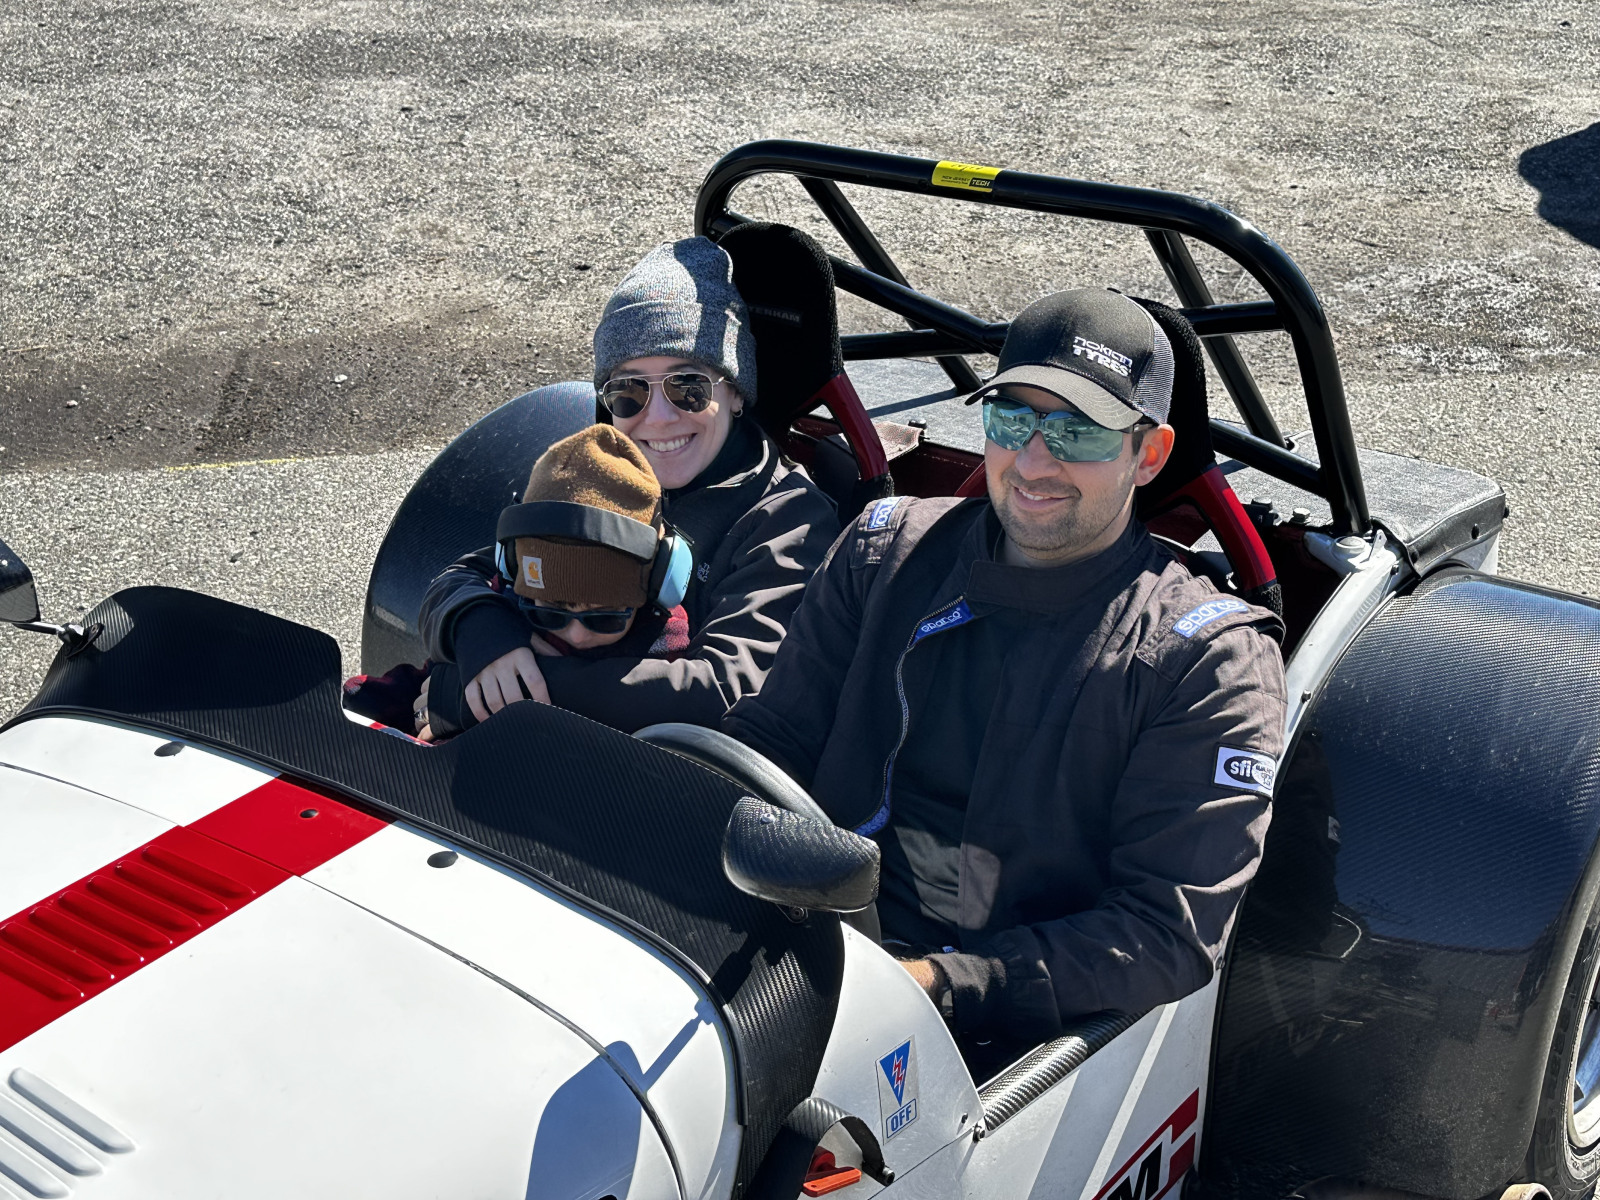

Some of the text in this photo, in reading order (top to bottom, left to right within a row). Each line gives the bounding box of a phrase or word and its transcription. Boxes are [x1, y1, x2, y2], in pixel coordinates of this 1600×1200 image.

[972, 179, 991, 187] TECH
[1073, 344, 1129, 377] TYRES
[921, 610, 962, 633] sparco
[1230, 760, 1252, 778] sfi
[890, 1105, 912, 1132] OFF
